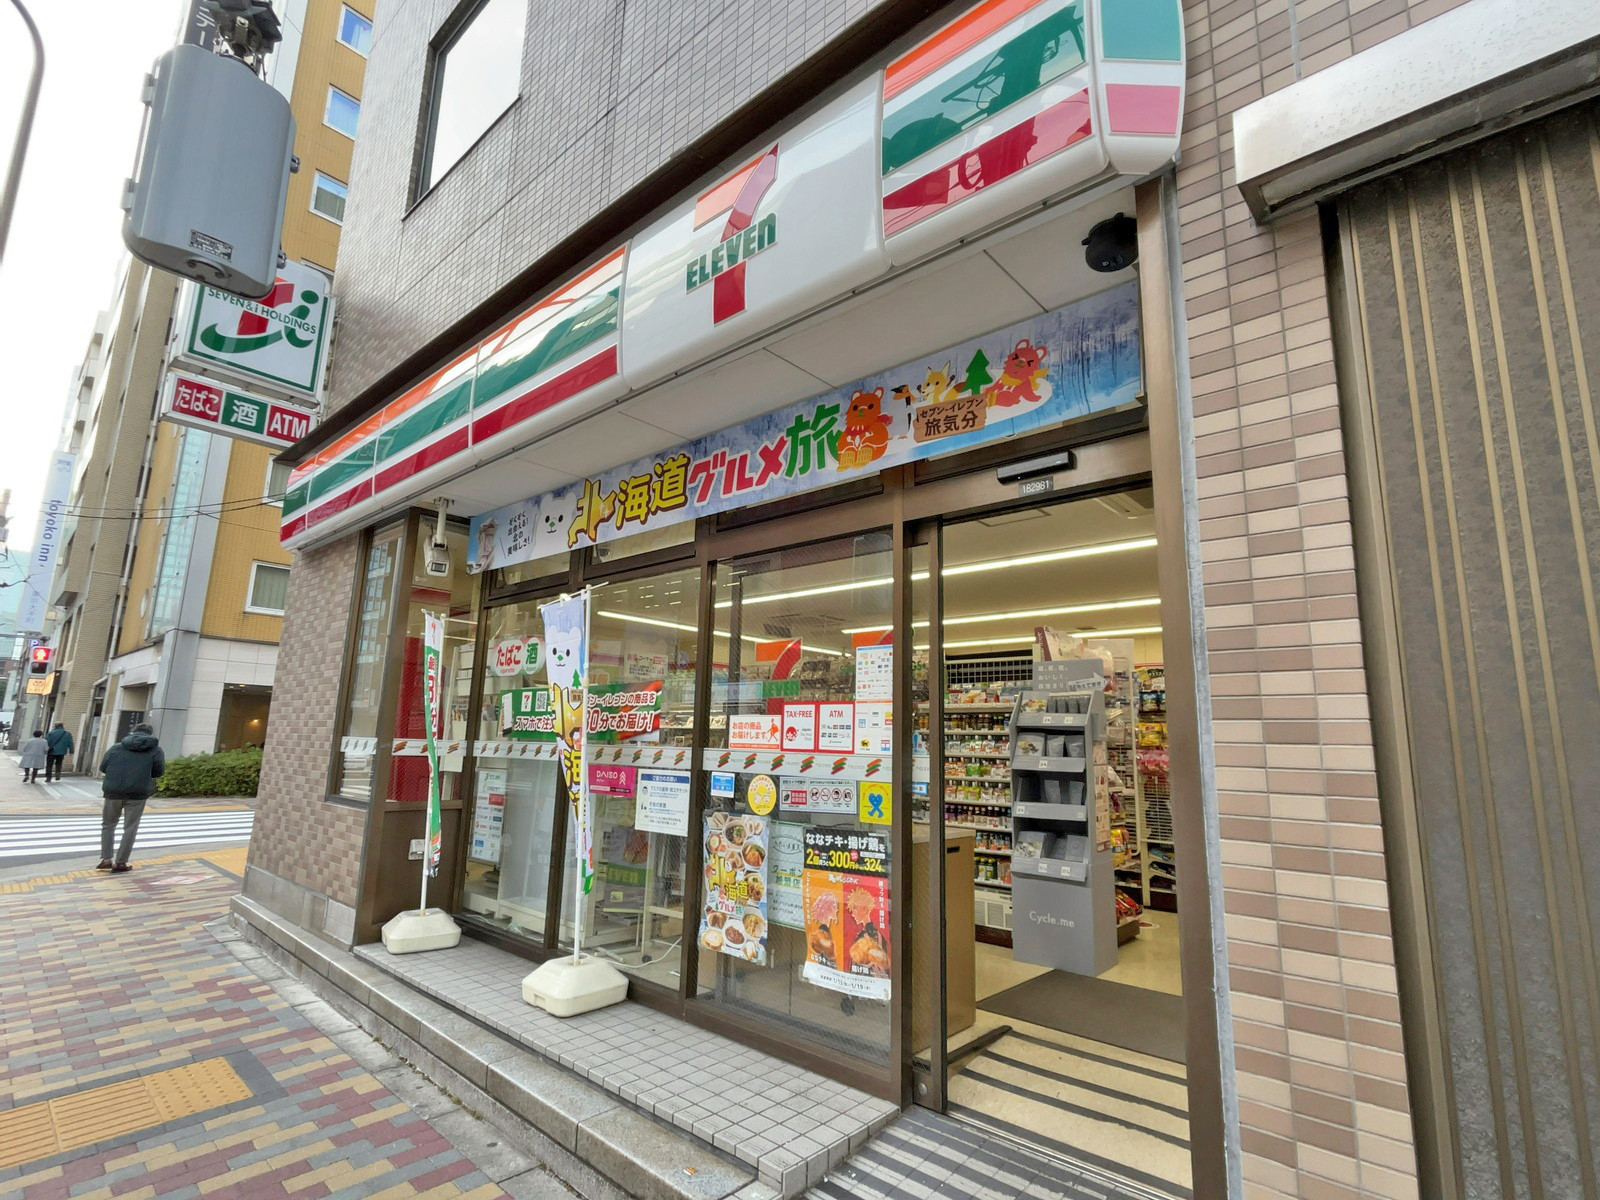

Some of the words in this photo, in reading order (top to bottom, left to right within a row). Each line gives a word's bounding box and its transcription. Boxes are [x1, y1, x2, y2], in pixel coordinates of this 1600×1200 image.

[261, 308, 317, 335] HOLDINGS
[175, 384, 220, 416] たばこ
[230, 399, 260, 427] 酒
[924, 410, 979, 437] 旅気分
[269, 412, 310, 440] ATM
[1022, 480, 1050, 494] 182981
[43, 499, 63, 540] toyoko
[496, 644, 522, 667] たばこ
[525, 642, 539, 665] 酒
[828, 710, 844, 718] ATM
[596, 770, 618, 779] DAISO
[1029, 910, 1075, 928] Cycle.me
